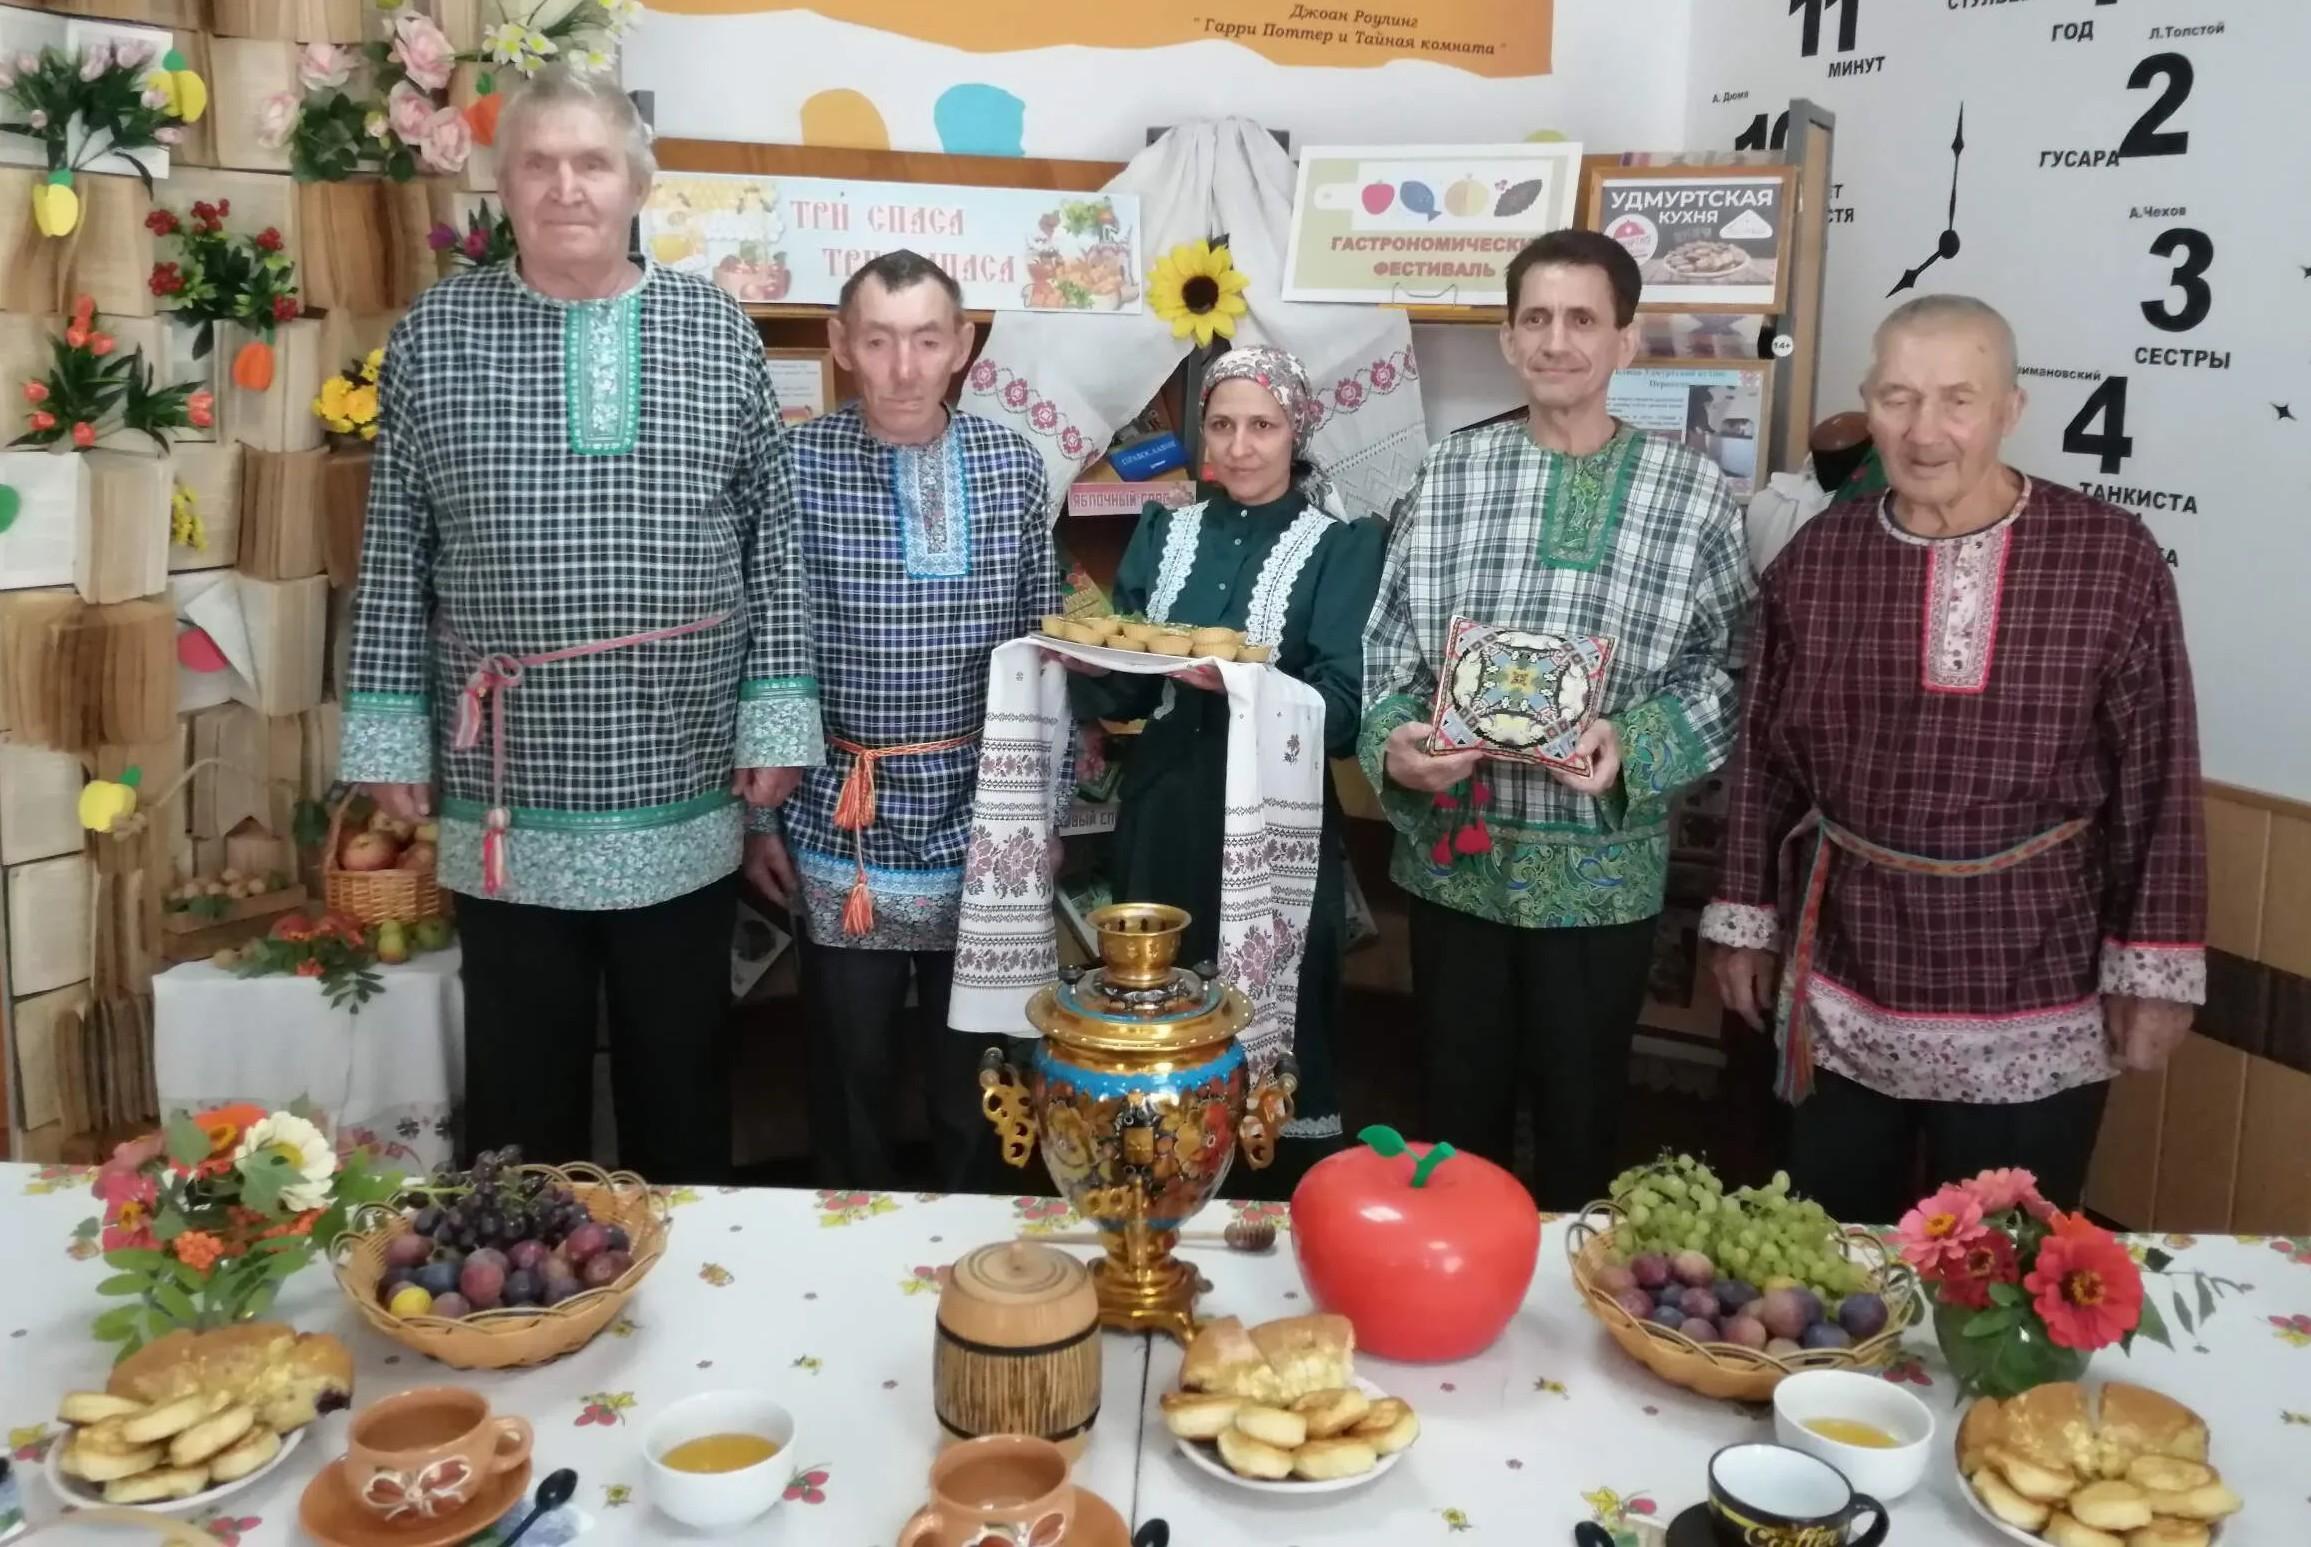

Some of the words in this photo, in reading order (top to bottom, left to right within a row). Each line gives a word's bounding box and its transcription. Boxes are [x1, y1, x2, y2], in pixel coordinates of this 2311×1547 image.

[1290, 4, 1348, 22] Джоан
[1353, 9, 1419, 29] Роулинг
[1204, 18, 1257, 37] Гарри
[1263, 23, 1333, 43] Поттер
[1338, 31, 1348, 43] и
[1354, 30, 1415, 49] Тайная
[1420, 39, 1495, 55] комната
[2051, 20, 2094, 43] ГОД
[2149, 22, 2226, 40] Л.Толстой
[1828, 56, 1886, 78] МИНУТ
[1723, 90, 1749, 103] Дюма
[2118, 52, 2195, 158] 2
[2038, 149, 2121, 169] ГУСАРА
[1610, 188, 1774, 212] УДМУРТСКАЯ
[789, 200, 850, 232] ТРИ
[867, 205, 965, 236] СПАСА
[1658, 210, 1719, 225] КУХНЯ
[2129, 204, 2187, 220] А.Чехов
[1373, 261, 1496, 278] ФЕСТИВАЛЬ
[2140, 228, 2215, 333] 3
[2134, 347, 2232, 370] СЕСТРЫ
[2017, 366, 2102, 382] имановский
[2062, 375, 2134, 475] 4
[2079, 482, 2198, 514] ТАНКИСТА
